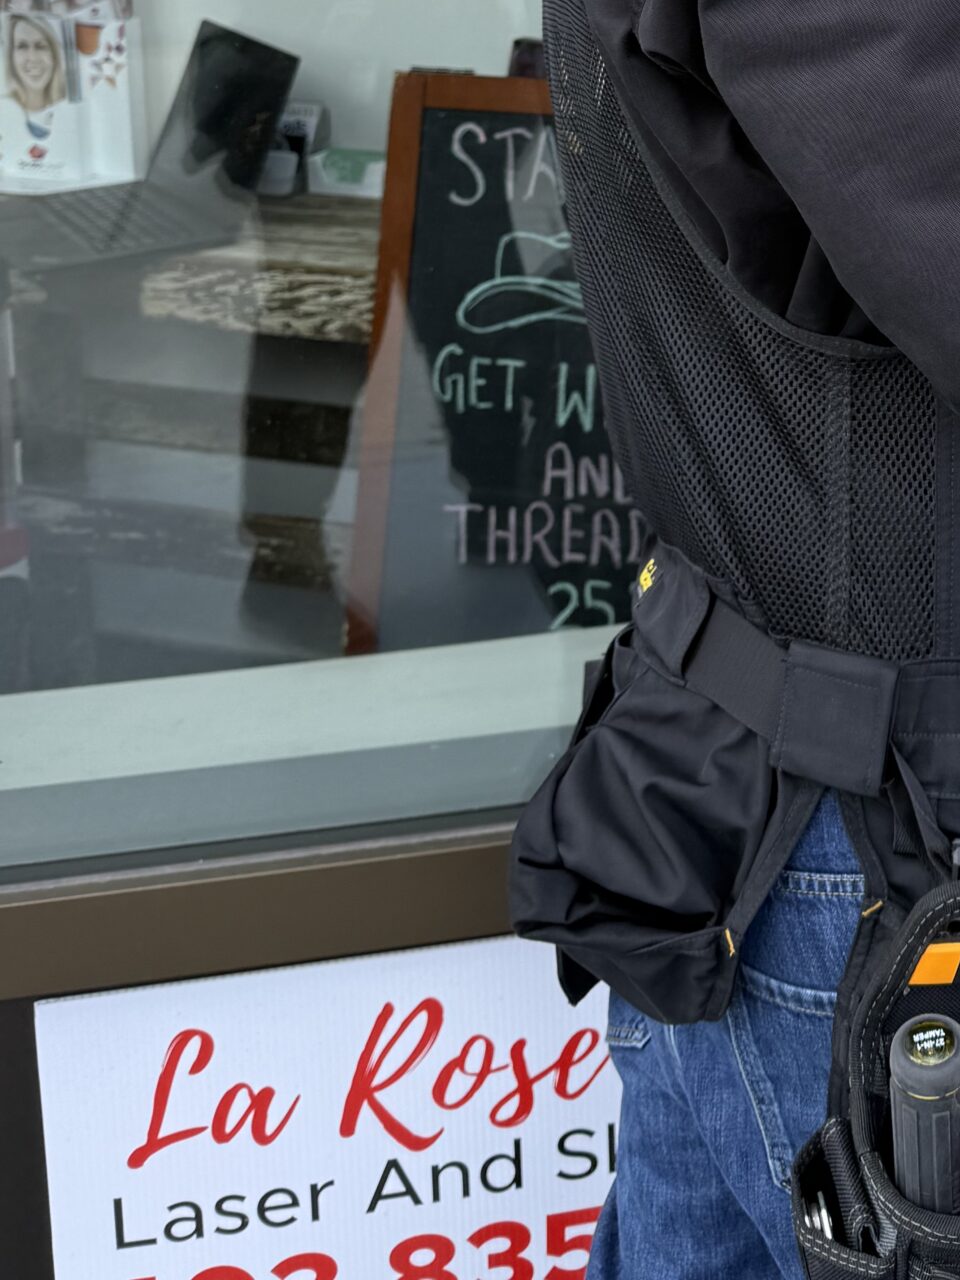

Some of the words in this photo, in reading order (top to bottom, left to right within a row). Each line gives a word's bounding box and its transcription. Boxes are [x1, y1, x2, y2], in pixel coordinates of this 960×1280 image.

[433, 343, 527, 414] GET
[127, 1028, 301, 1169] La
[339, 997, 610, 1152] Rose
[113, 1180, 335, 1250] Laser
[366, 1138, 523, 1214] And
